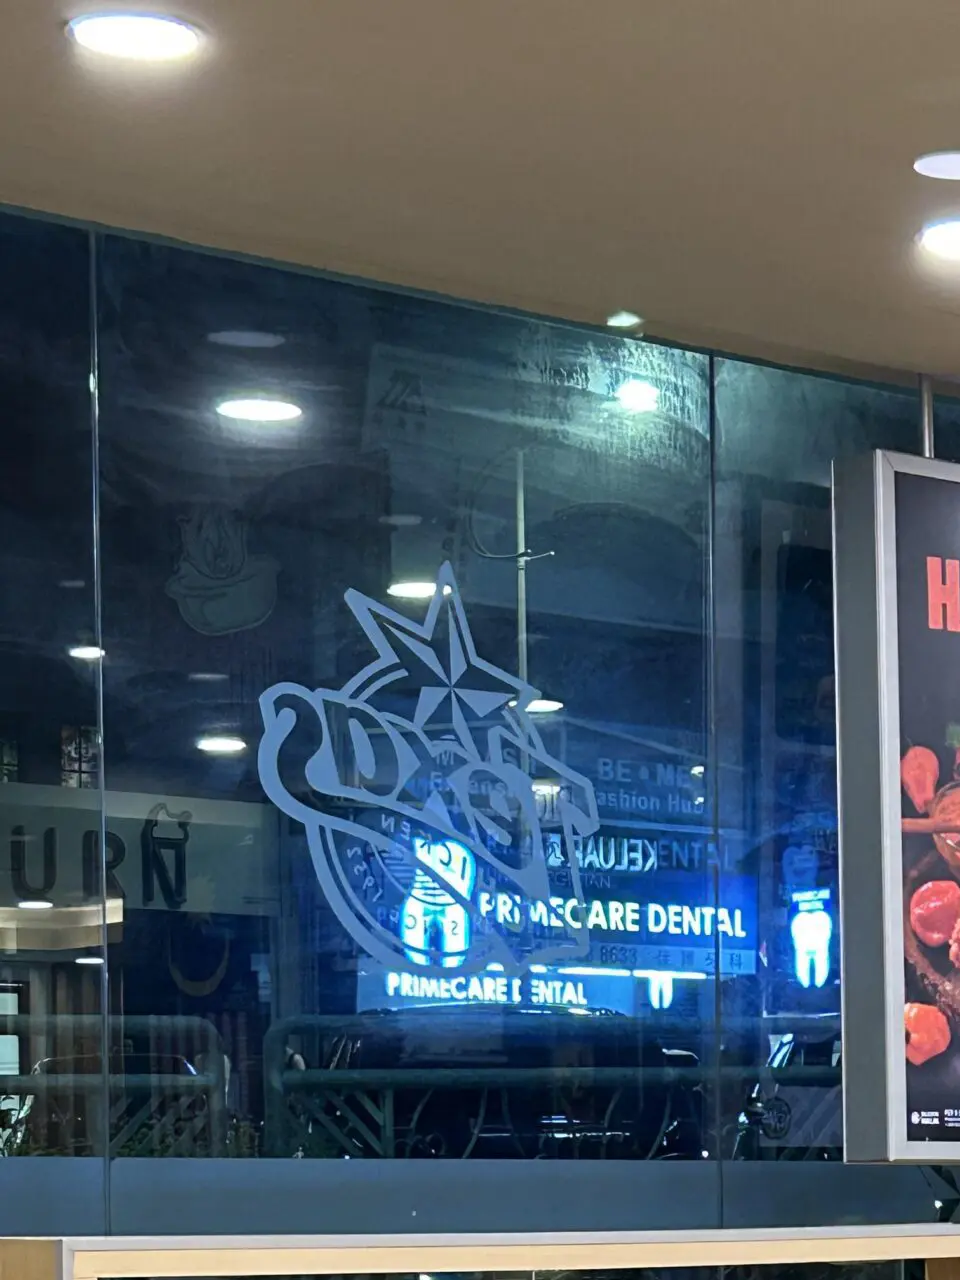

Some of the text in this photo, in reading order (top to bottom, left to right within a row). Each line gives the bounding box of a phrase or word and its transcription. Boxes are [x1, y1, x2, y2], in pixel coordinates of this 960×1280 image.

[594, 788, 661, 811] ashion
[656, 838, 734, 873] ENTAL
[647, 903, 747, 938] DENTAL
